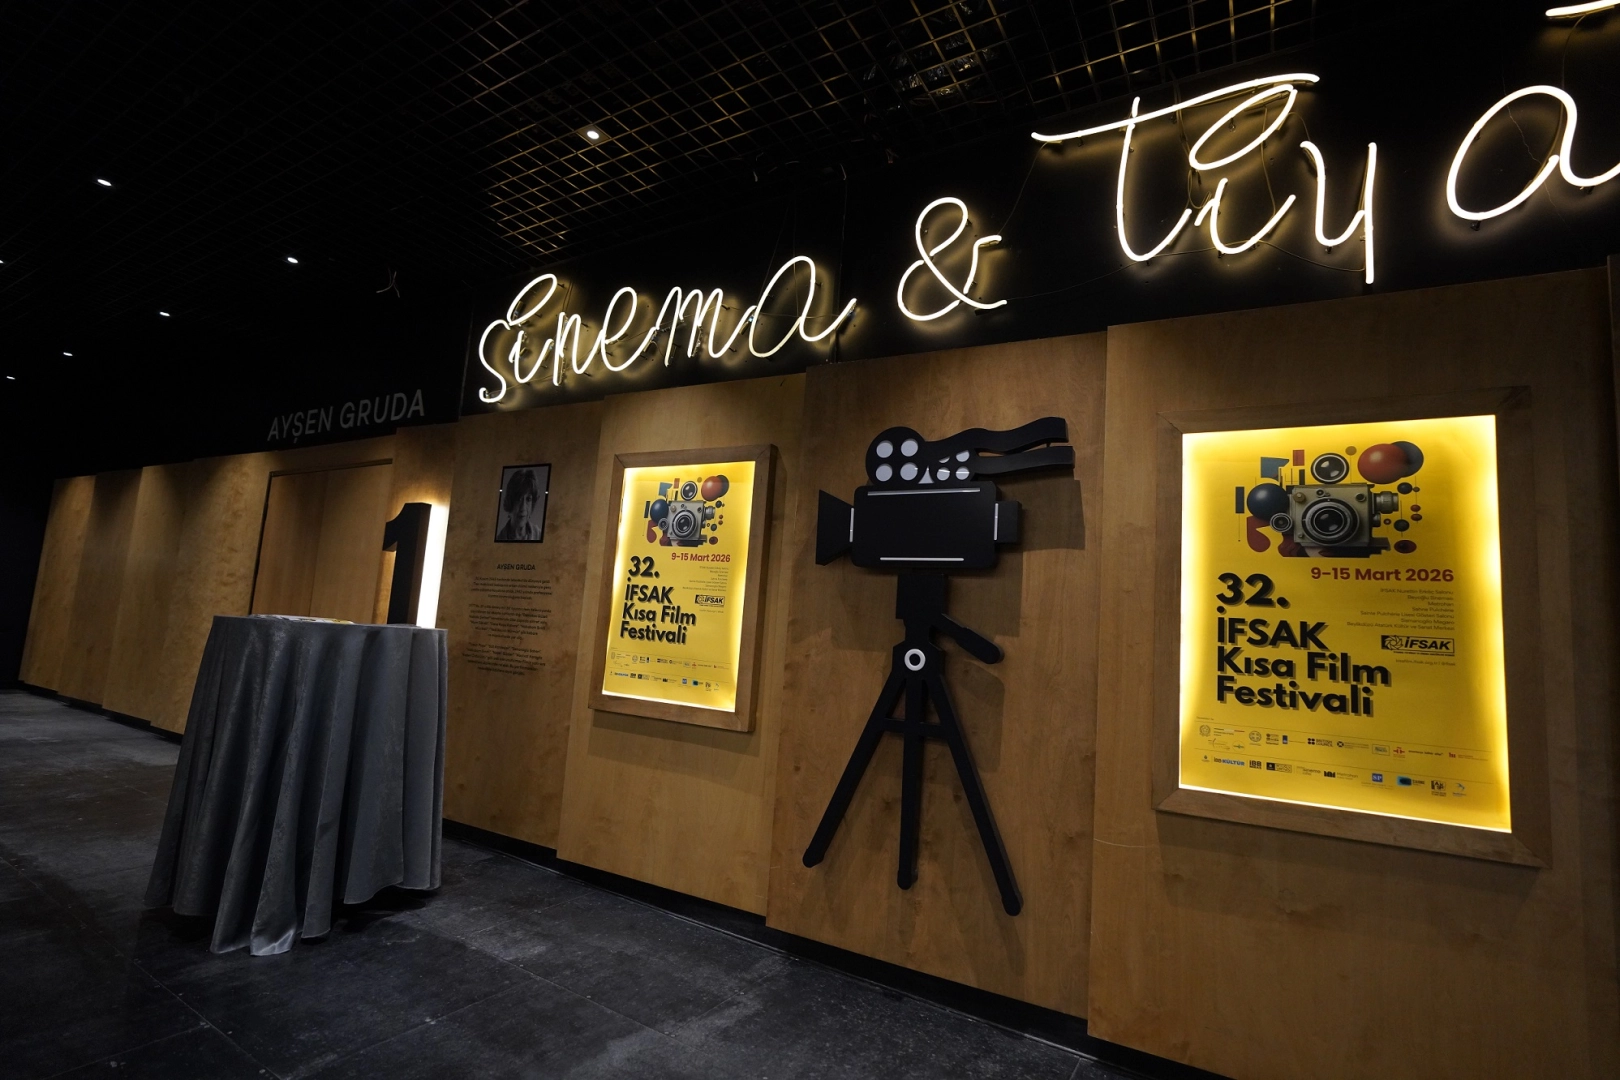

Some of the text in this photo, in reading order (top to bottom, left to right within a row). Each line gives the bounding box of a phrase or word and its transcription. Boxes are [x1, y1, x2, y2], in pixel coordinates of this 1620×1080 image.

[479, 0, 1620, 402] sinema & tiya
[267, 389, 425, 444] AYŞEN GRUDA
[382, 502, 432, 625] 1
[497, 563, 536, 571] AYŞEN GRUDA
[628, 556, 660, 579] 32.
[690, 553, 710, 562] Mart
[710, 554, 731, 563] 2026
[1355, 568, 1401, 582] Mart
[1405, 568, 1454, 582] 2026
[625, 577, 674, 604] İFSAK
[1216, 572, 1290, 608] 32.
[622, 602, 697, 626] Kısa Film
[620, 620, 687, 645] Festivali
[1216, 606, 1330, 650] İFSAK
[1404, 636, 1452, 650] İFSAK
[1217, 646, 1392, 687] Kısa Film
[1216, 675, 1374, 717] Festivali
